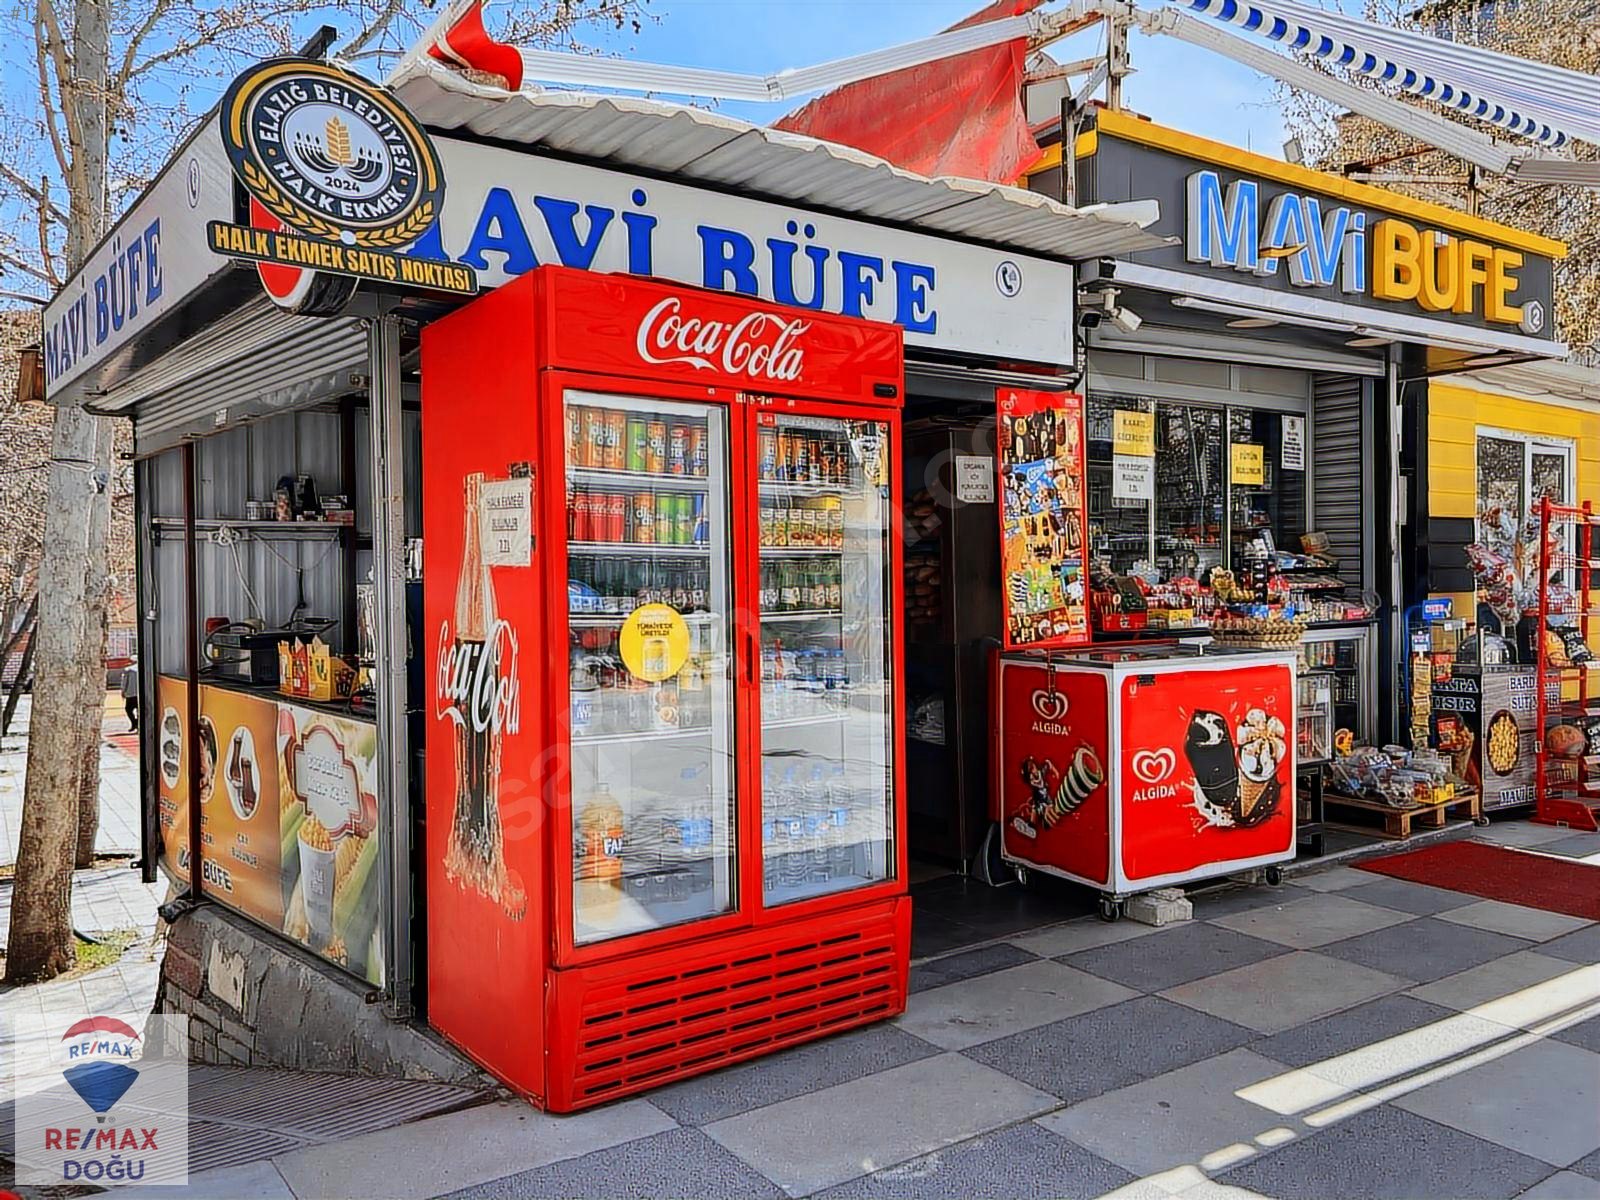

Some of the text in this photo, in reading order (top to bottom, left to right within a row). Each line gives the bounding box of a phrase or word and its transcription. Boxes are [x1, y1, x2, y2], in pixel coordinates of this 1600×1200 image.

[259, 82, 417, 177] ELAZIĞ BELEDİYESİ
[273, 162, 407, 219] HALK EKMEK
[324, 176, 361, 193] 2024
[46, 217, 163, 385] MAVİ BÜFE
[214, 225, 269, 256] HALK
[275, 236, 346, 270] EKMEK
[346, 251, 397, 281] SATIŞ
[401, 260, 471, 291] NOKTASI
[696, 221, 938, 335] BÜFE
[1373, 218, 1524, 324] BÜFE
[636, 297, 811, 382] Coca-Cola
[436, 620, 520, 736] Coca-Cola
[201, 859, 233, 894] BÜFE
